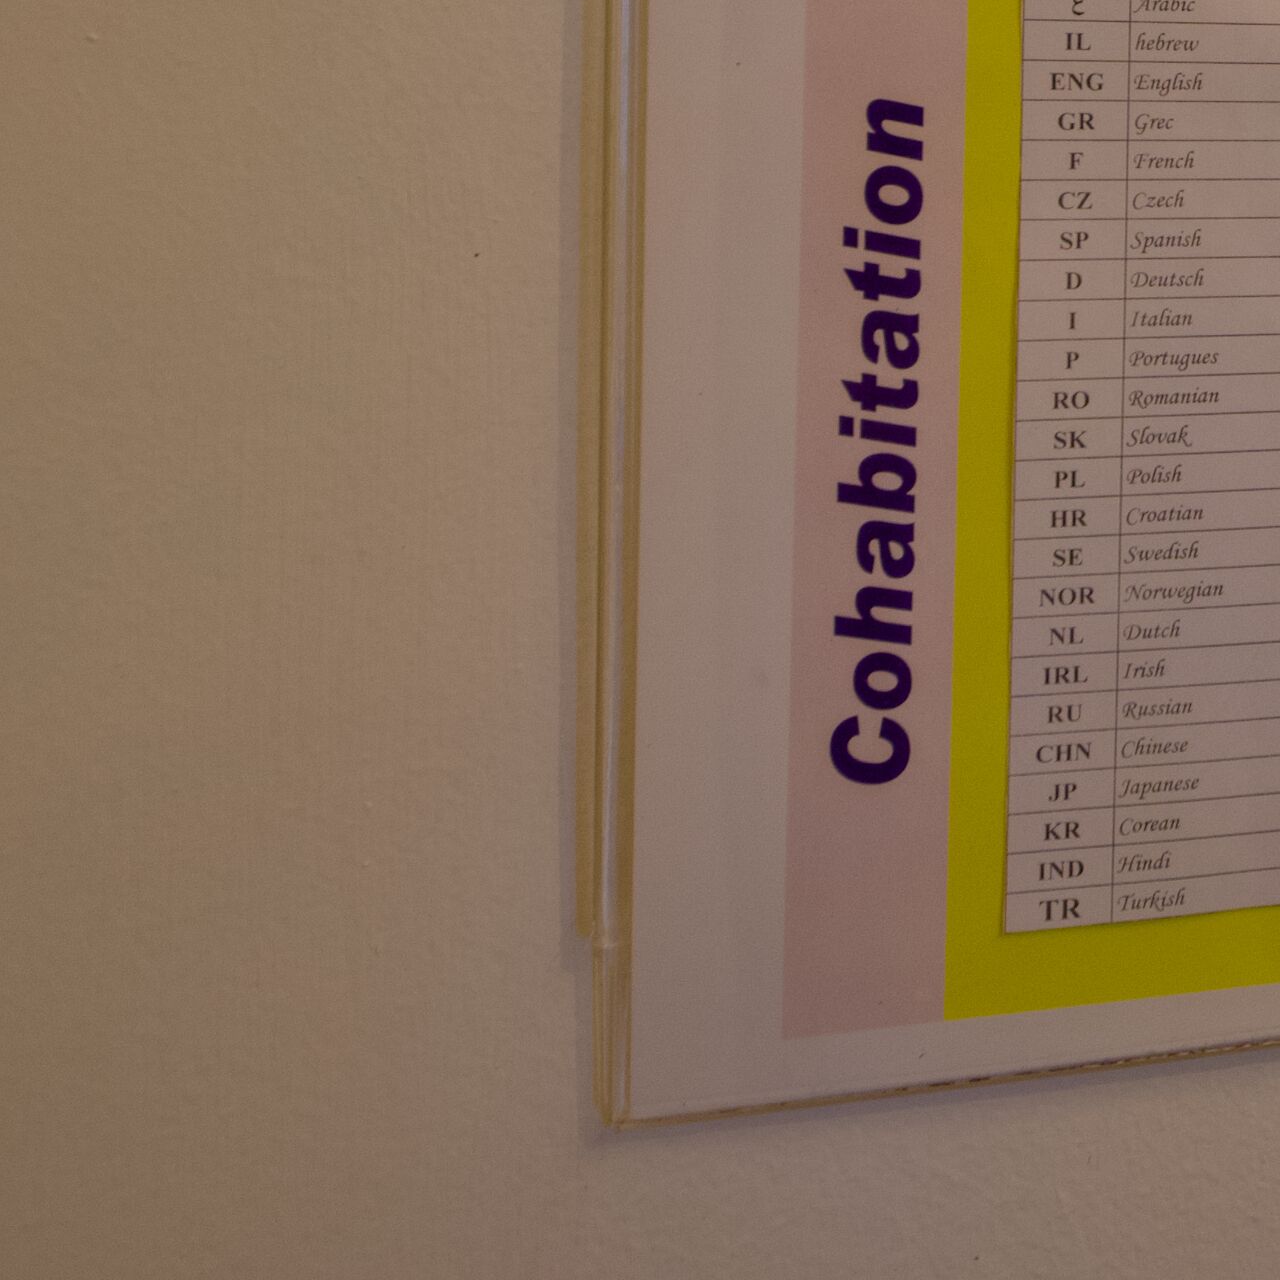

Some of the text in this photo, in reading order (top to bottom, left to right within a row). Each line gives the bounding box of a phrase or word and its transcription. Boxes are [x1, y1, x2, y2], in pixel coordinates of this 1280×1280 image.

[1067, 33, 1090, 50] IL
[1136, 32, 1199, 51] hebrew
[1051, 73, 1103, 91] ENG
[1134, 72, 1202, 96] English
[1058, 113, 1094, 130] GR
[1135, 114, 1174, 135] Grec
[1070, 153, 1083, 169] F
[1134, 151, 1194, 168] French
[1058, 192, 1092, 209] CZ
[1133, 190, 1184, 210] Czech
[1060, 232, 1089, 249] SP
[1130, 229, 1201, 254] Spanish
[1067, 272, 1082, 289] D
[1131, 268, 1204, 287] Deutsch
[1070, 312, 1075, 329] I
[1132, 308, 1192, 327] Italian
[1067, 352, 1079, 369] P
[1129, 351, 1219, 371] Portugues
[1054, 392, 1089, 409] RO
[1129, 391, 1219, 409] Romanian
[829, 97, 925, 786] Cohabitation
[1054, 431, 1085, 448] SK
[1126, 425, 1192, 447] Slovak
[1055, 471, 1085, 488] PL
[1127, 464, 1182, 484] Polish
[1052, 510, 1086, 527] HR
[1126, 508, 1203, 525] Croatian
[1053, 549, 1082, 566] SE
[1124, 541, 1198, 564] Swedish
[1040, 587, 1094, 606] NOR
[1125, 581, 1223, 604] Norwegian
[1050, 627, 1083, 645] NL
[1123, 619, 1180, 640] Dutch
[1045, 666, 1087, 684] IRL
[1124, 659, 1165, 679] Irish
[1048, 704, 1081, 723] RU
[1123, 699, 1192, 720] Russian
[1036, 743, 1091, 762] CHN
[1121, 737, 1188, 758] Chinese
[1049, 784, 1076, 801] JP
[1118, 779, 1199, 800] Japanese
[1045, 822, 1079, 840] KR
[1120, 818, 1180, 835] Corean
[1040, 861, 1084, 880] IND
[1118, 851, 1170, 873] Hindi
[1118, 887, 1185, 912] Turkish
[1040, 899, 1080, 921] TR
